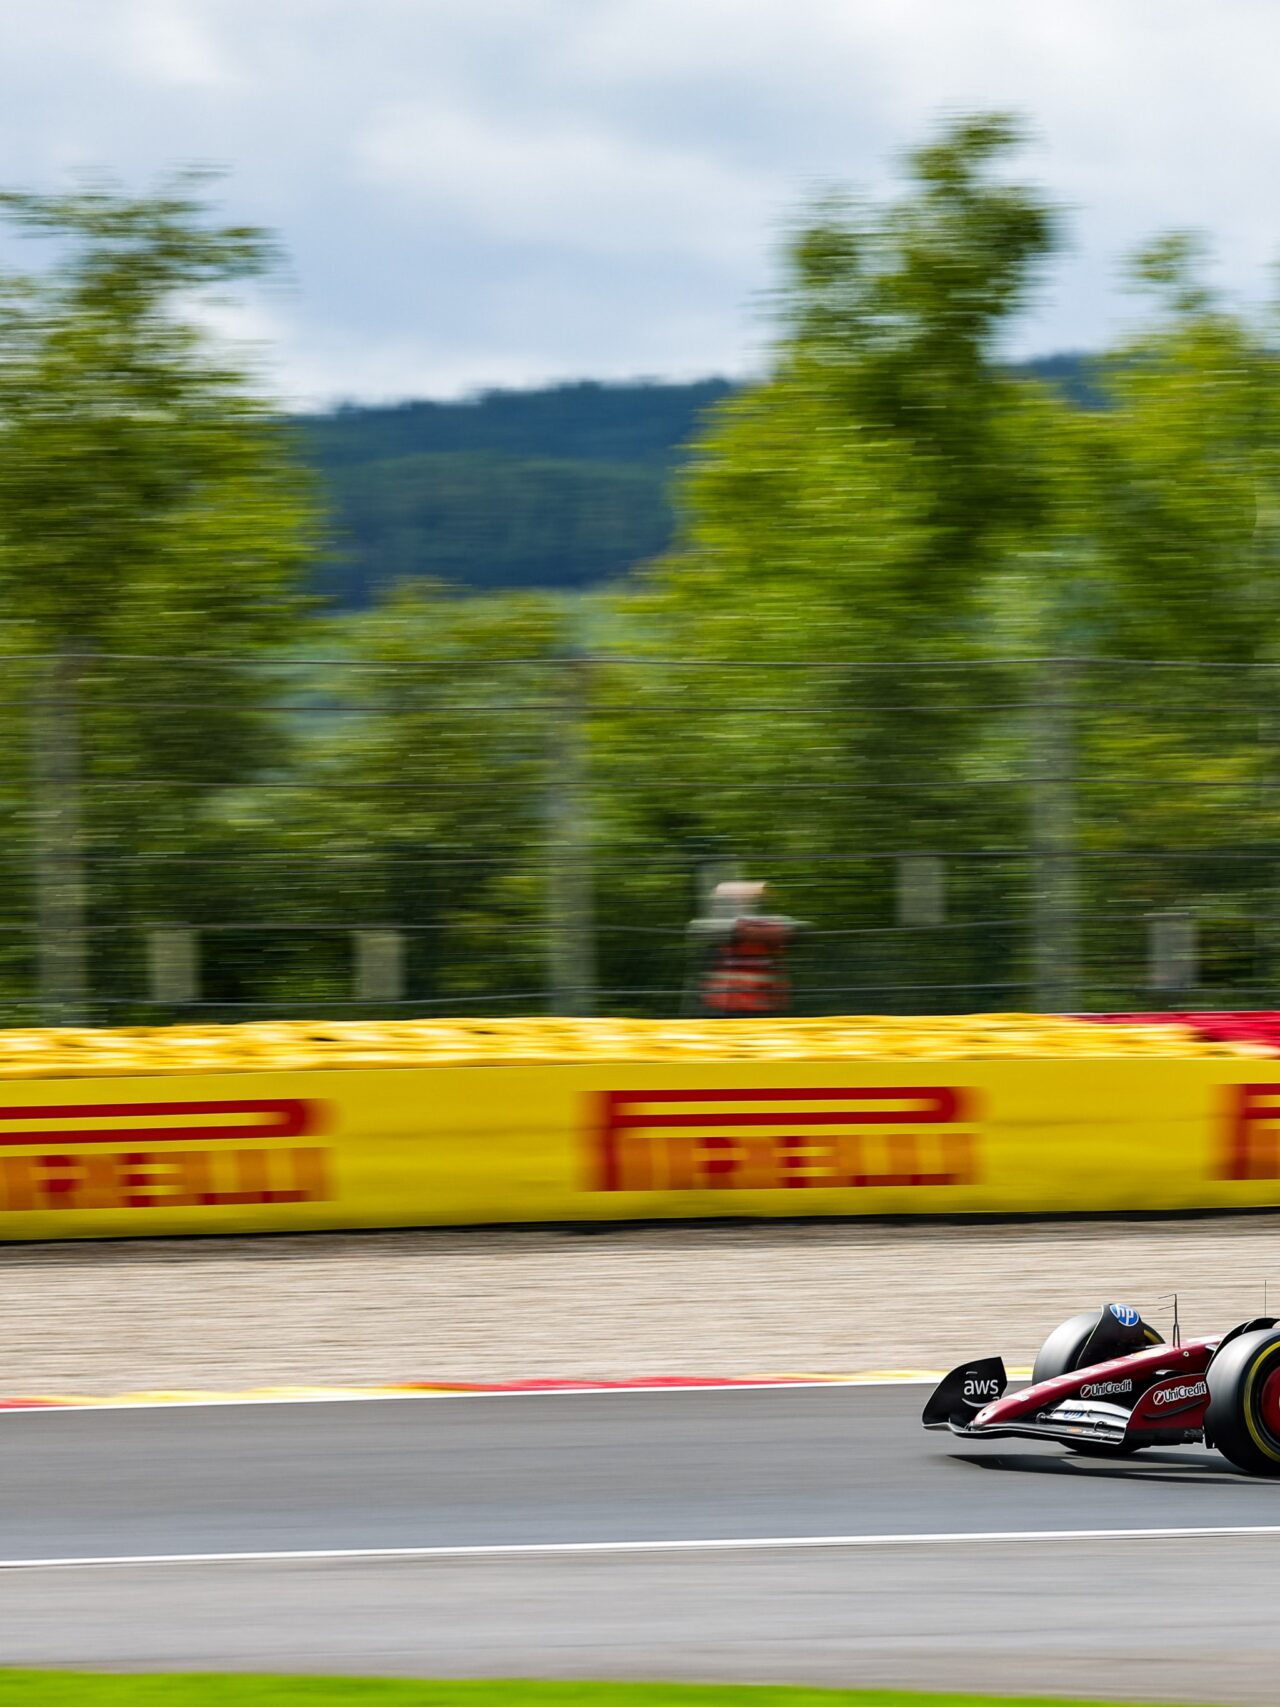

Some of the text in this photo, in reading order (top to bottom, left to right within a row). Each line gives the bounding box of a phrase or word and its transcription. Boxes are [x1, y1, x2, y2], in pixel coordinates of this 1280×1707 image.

[584, 1087, 977, 1191] PIRELLI
[1112, 1304, 1135, 1326] hp
[963, 1378, 1000, 1396] aws
[1090, 1379, 1133, 1396] UniCredit
[1163, 1381, 1207, 1402] UniCredit
